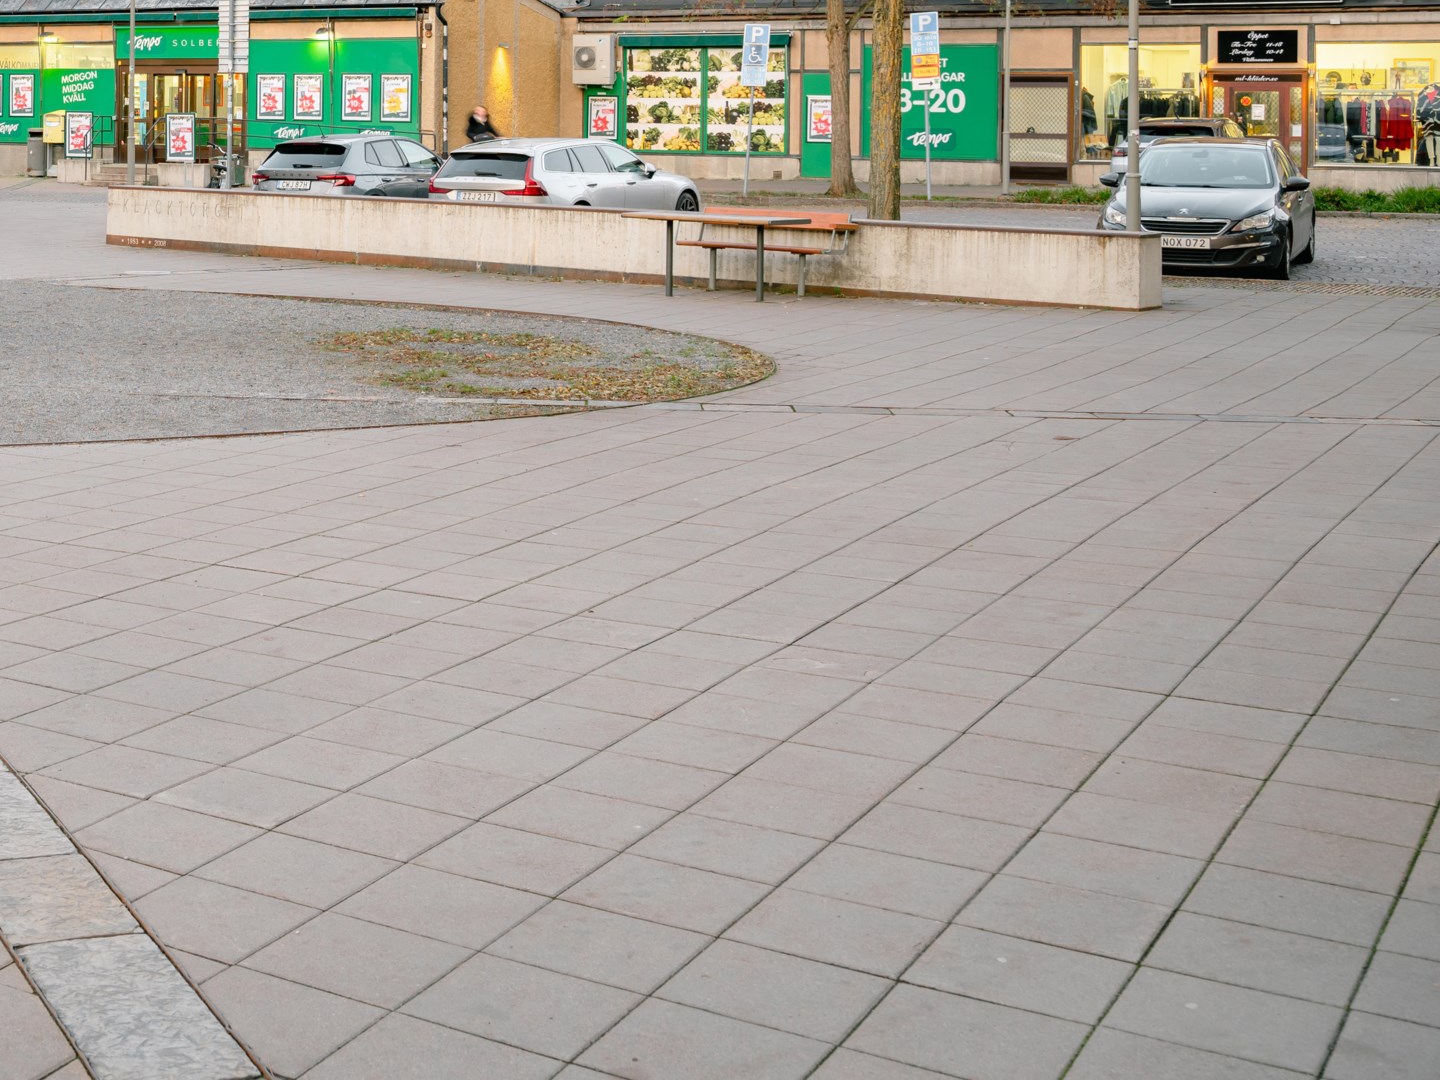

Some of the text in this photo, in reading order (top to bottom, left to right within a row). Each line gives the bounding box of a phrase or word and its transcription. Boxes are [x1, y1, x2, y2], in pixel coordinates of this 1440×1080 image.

[919, 15, 931, 31] P
[751, 26, 764, 43] P
[1247, 31, 1269, 40] Öppet
[61, 71, 98, 84] MORGON
[62, 82, 94, 93] MIDDAG
[62, 93, 86, 104] KVÄLL
[462, 192, 476, 200] ZZJ
[1162, 238, 1205, 247] NOX 072
